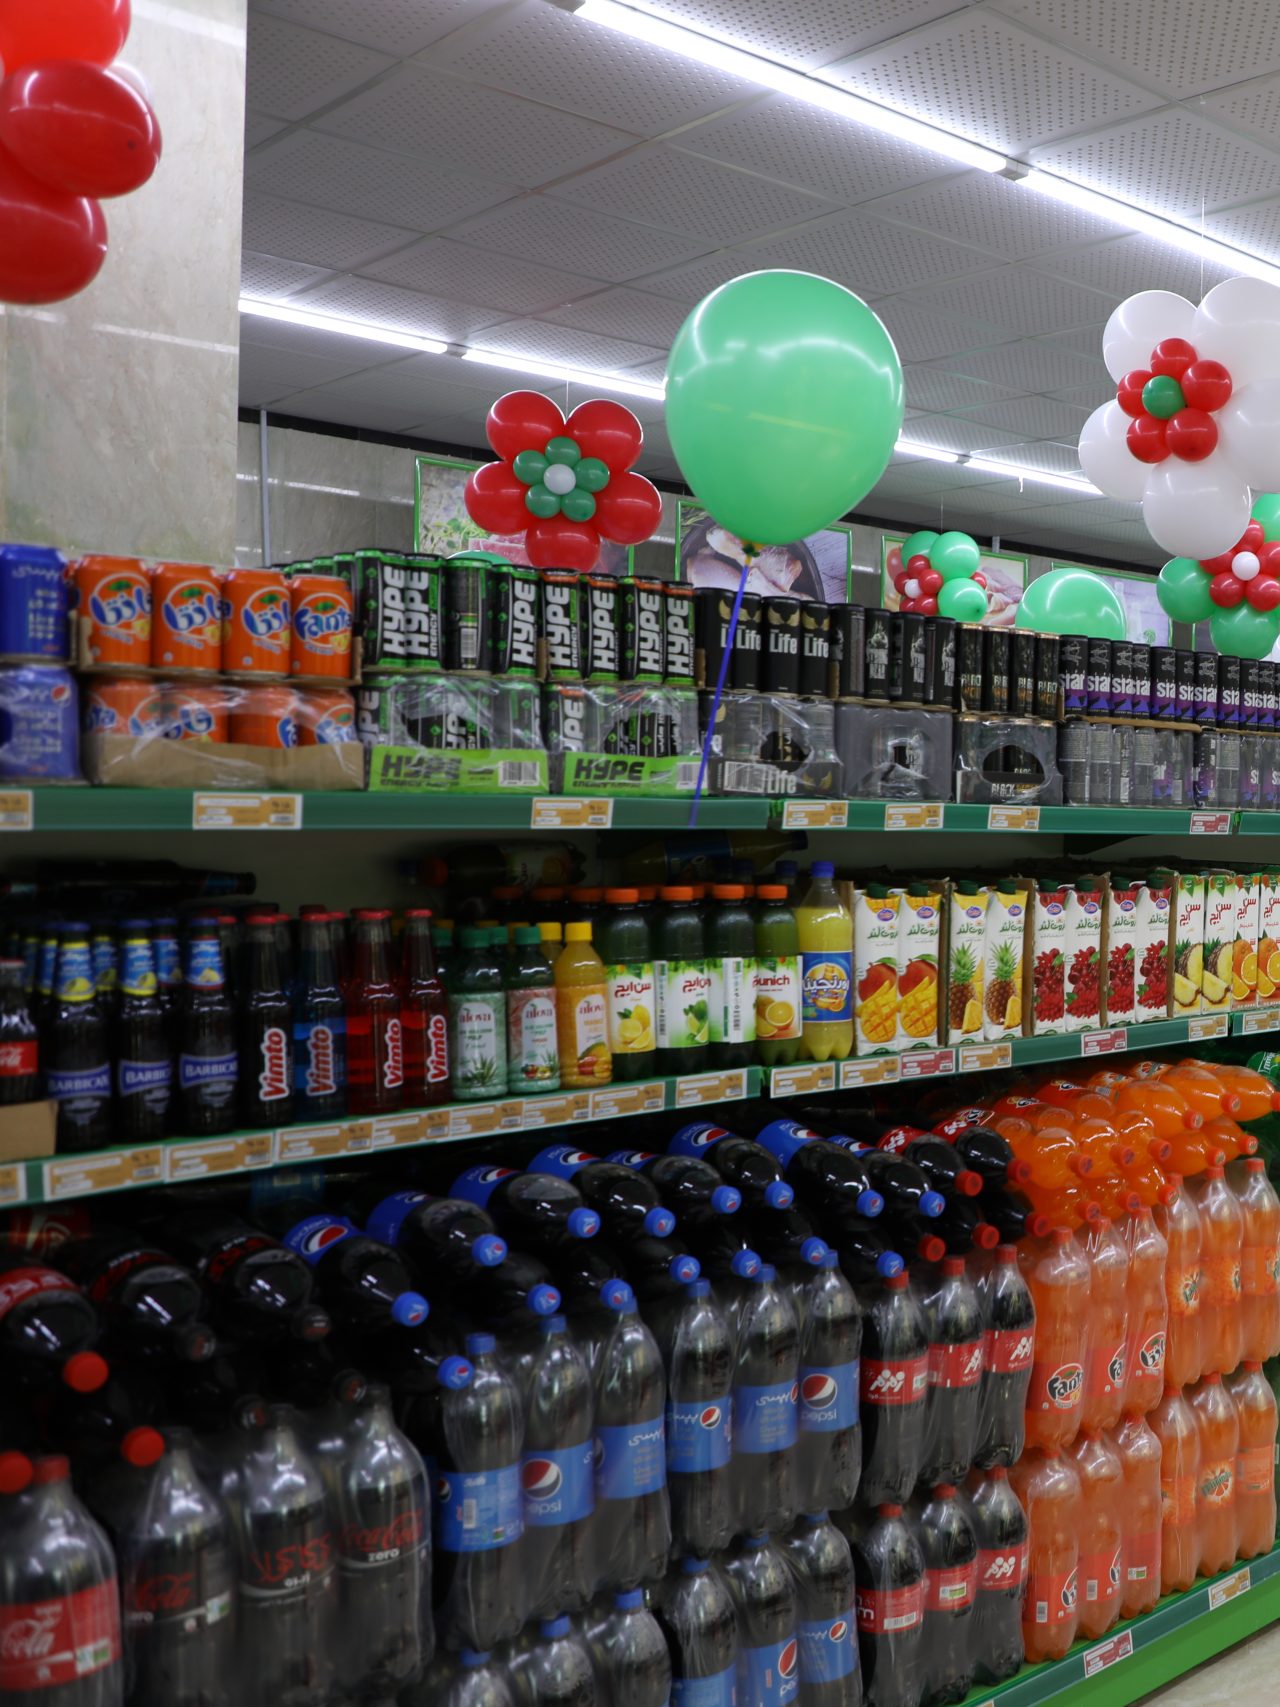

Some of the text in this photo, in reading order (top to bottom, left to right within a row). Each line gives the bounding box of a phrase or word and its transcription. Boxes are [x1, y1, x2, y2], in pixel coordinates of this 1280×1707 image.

[383, 566, 405, 655] HYPE
[405, 570, 429, 656] HYPE
[512, 580, 536, 665] HYPE
[546, 585, 570, 667] HYPE
[593, 590, 615, 670] HYPE
[640, 592, 661, 672] HYPE
[667, 598, 689, 675] HYPE
[769, 632, 798, 655] Life
[574, 759, 645, 780] HYPE
[767, 767, 797, 794] Life
[125, 1067, 170, 1085] BARBIC
[260, 1028, 289, 1100] Vimto
[307, 1026, 336, 1096] Vimto
[385, 1019, 403, 1087] Vimto
[428, 1015, 449, 1082] Vimto
[368, 1548, 400, 1562] zero
